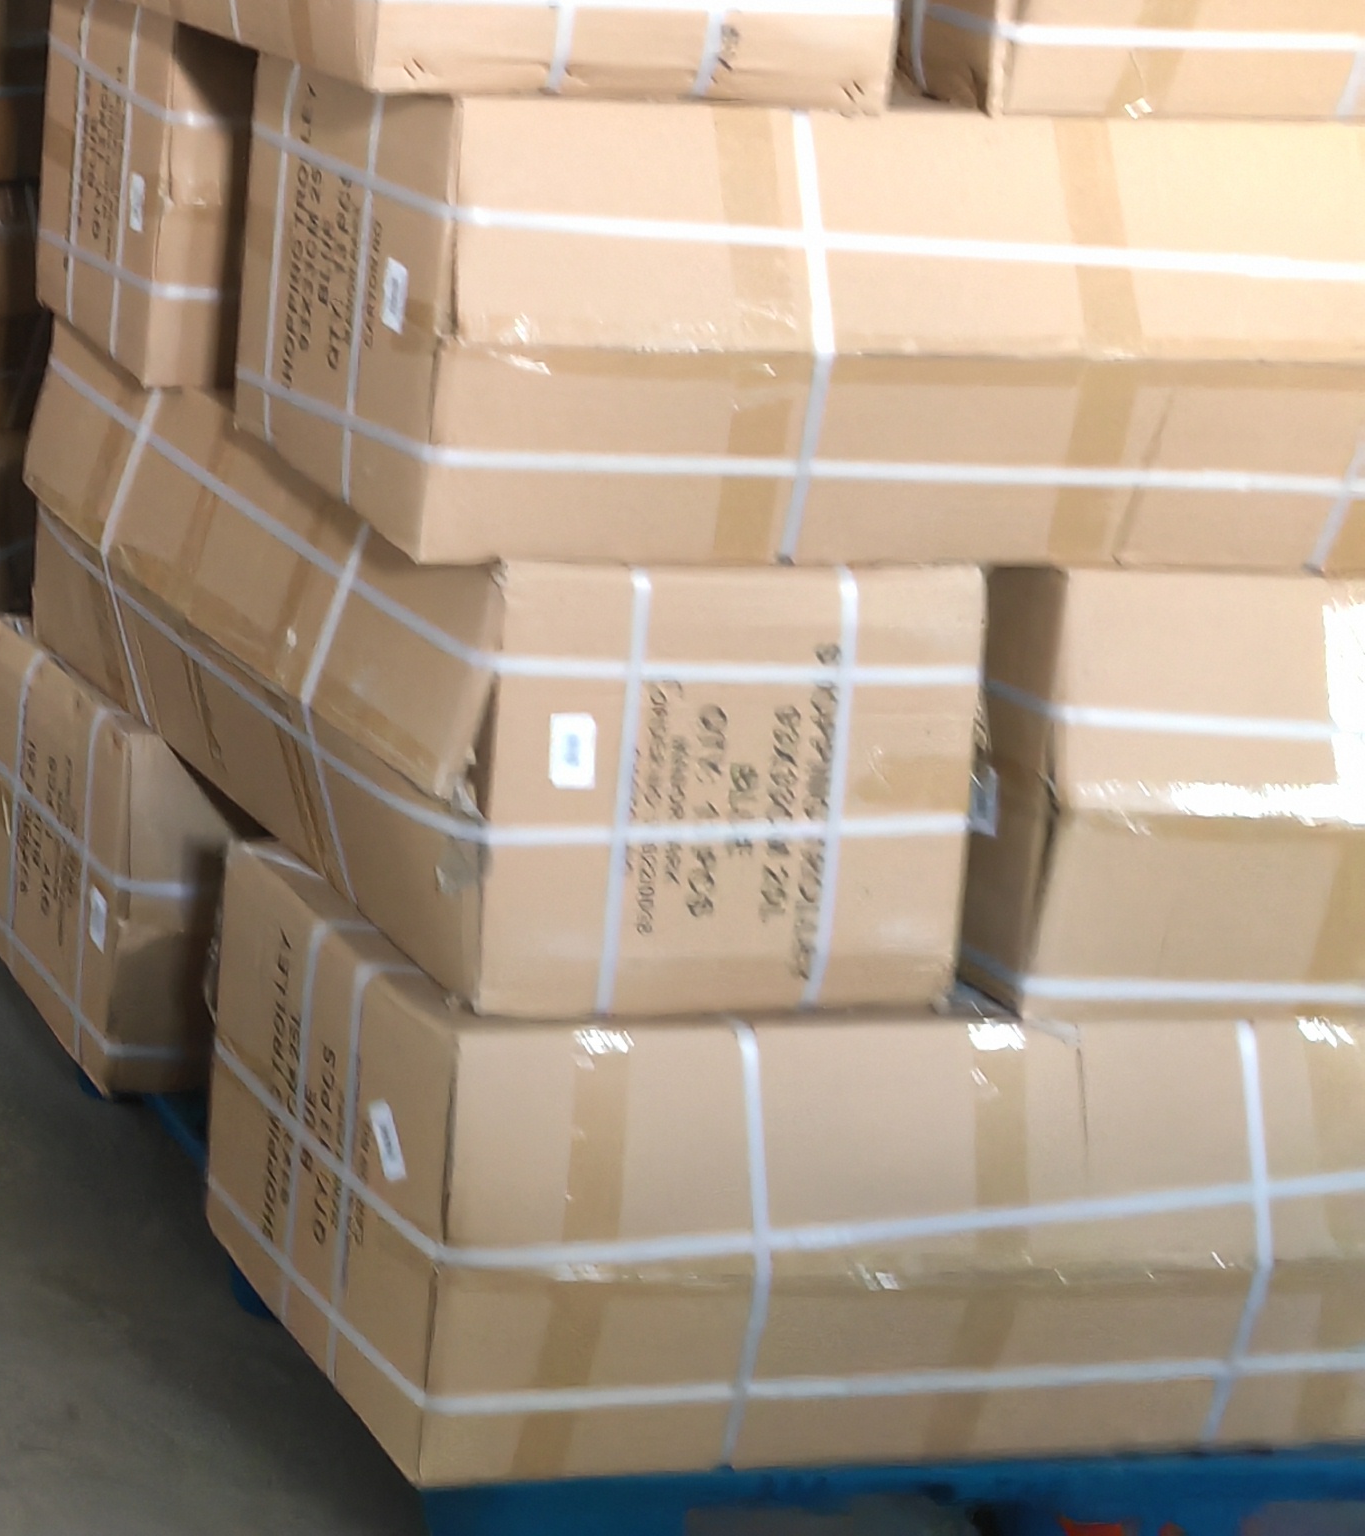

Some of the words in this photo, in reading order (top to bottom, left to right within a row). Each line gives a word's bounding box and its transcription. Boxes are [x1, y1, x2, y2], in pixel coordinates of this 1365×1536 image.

[316, 221, 333, 306] BLUE
[363, 260, 380, 350] CARTON
[281, 239, 302, 388] HOPPING
[321, 1043, 337, 1112] PCS
[299, 1085, 317, 1172] BUE
